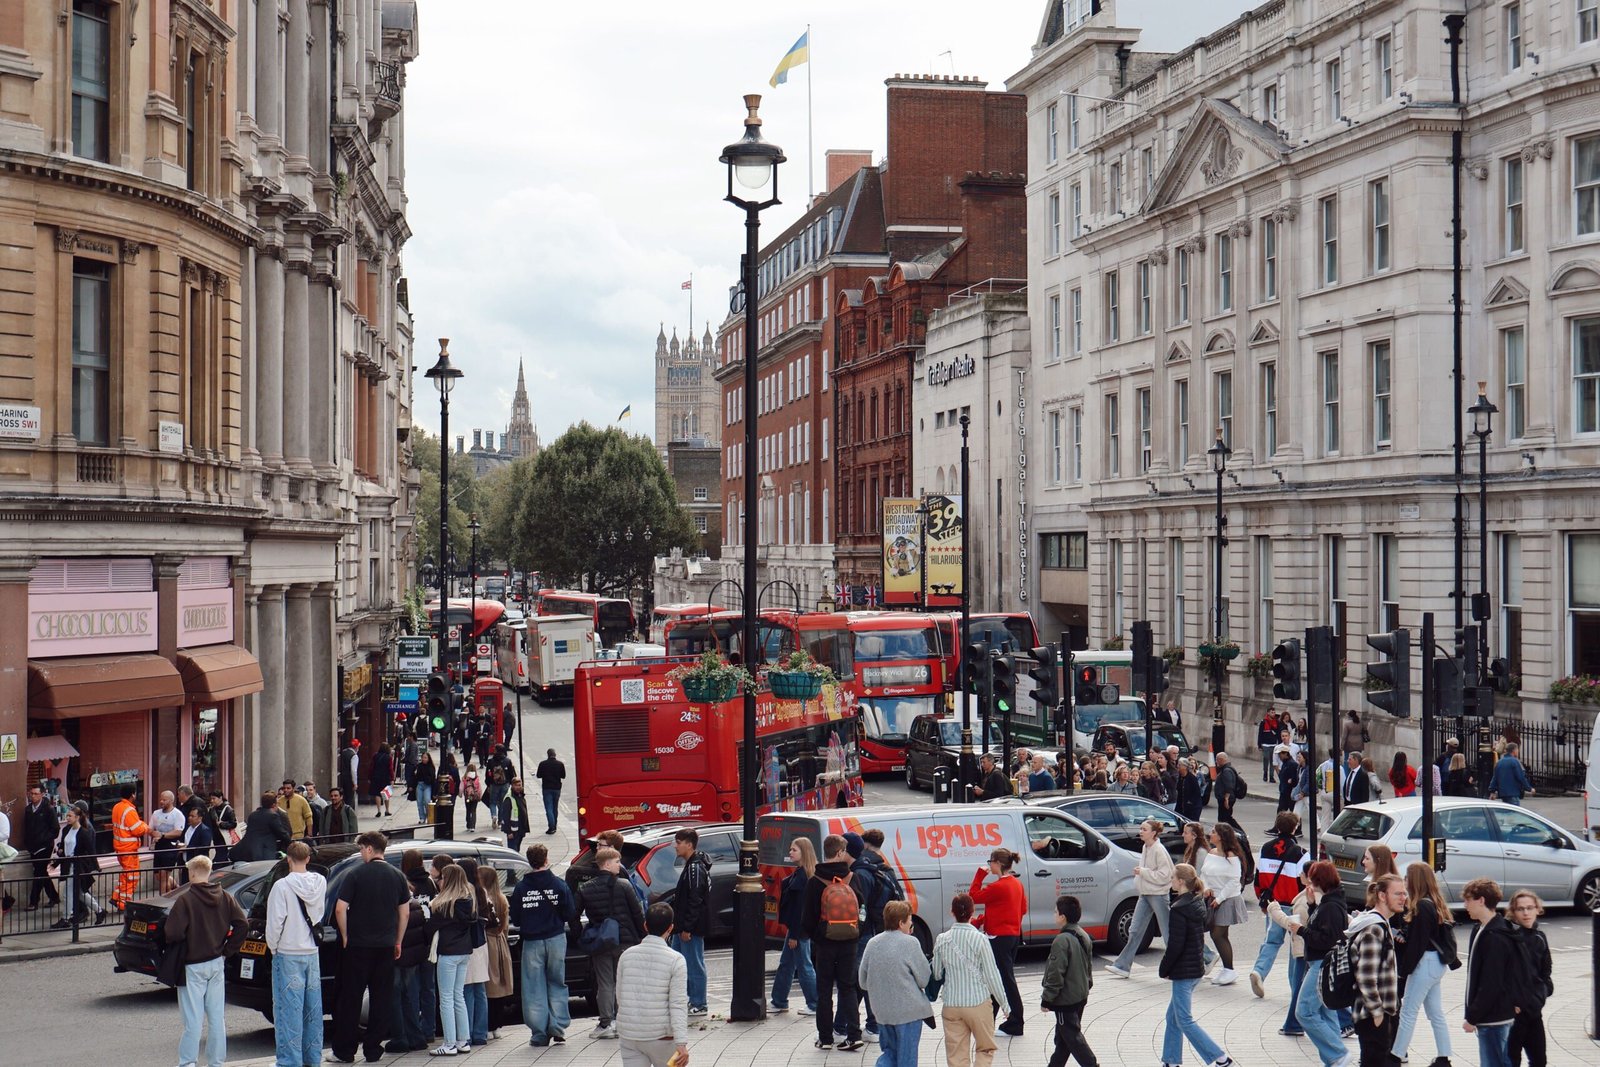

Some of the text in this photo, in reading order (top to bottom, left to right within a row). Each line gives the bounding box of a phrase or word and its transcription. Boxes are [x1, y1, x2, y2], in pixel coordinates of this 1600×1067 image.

[928, 354, 975, 387] Trafalgar Theatre
[22, 420, 38, 428] SW1
[1018, 370, 1027, 600] Trafalgar Theatre
[885, 504, 913, 514] WEST END
[928, 502, 943, 511] THE
[885, 514, 919, 525] BROADWAY
[929, 503, 959, 534] 39
[885, 524, 919, 535] HIT IS BACK!
[938, 524, 962, 541] STEP
[183, 606, 226, 629] CHOCOLICIOUS
[36, 612, 148, 638] CHOCOLICIOUS
[863, 669, 888, 677] Hackney
[914, 666, 928, 678] 26
[647, 687, 678, 695] discover
[661, 694, 675, 702] city
[677, 736, 702, 746] OFFICIAL
[655, 746, 675, 754] 15030
[656, 802, 702, 813] City Tour
[522, 894, 559, 902] DEPARTENT
